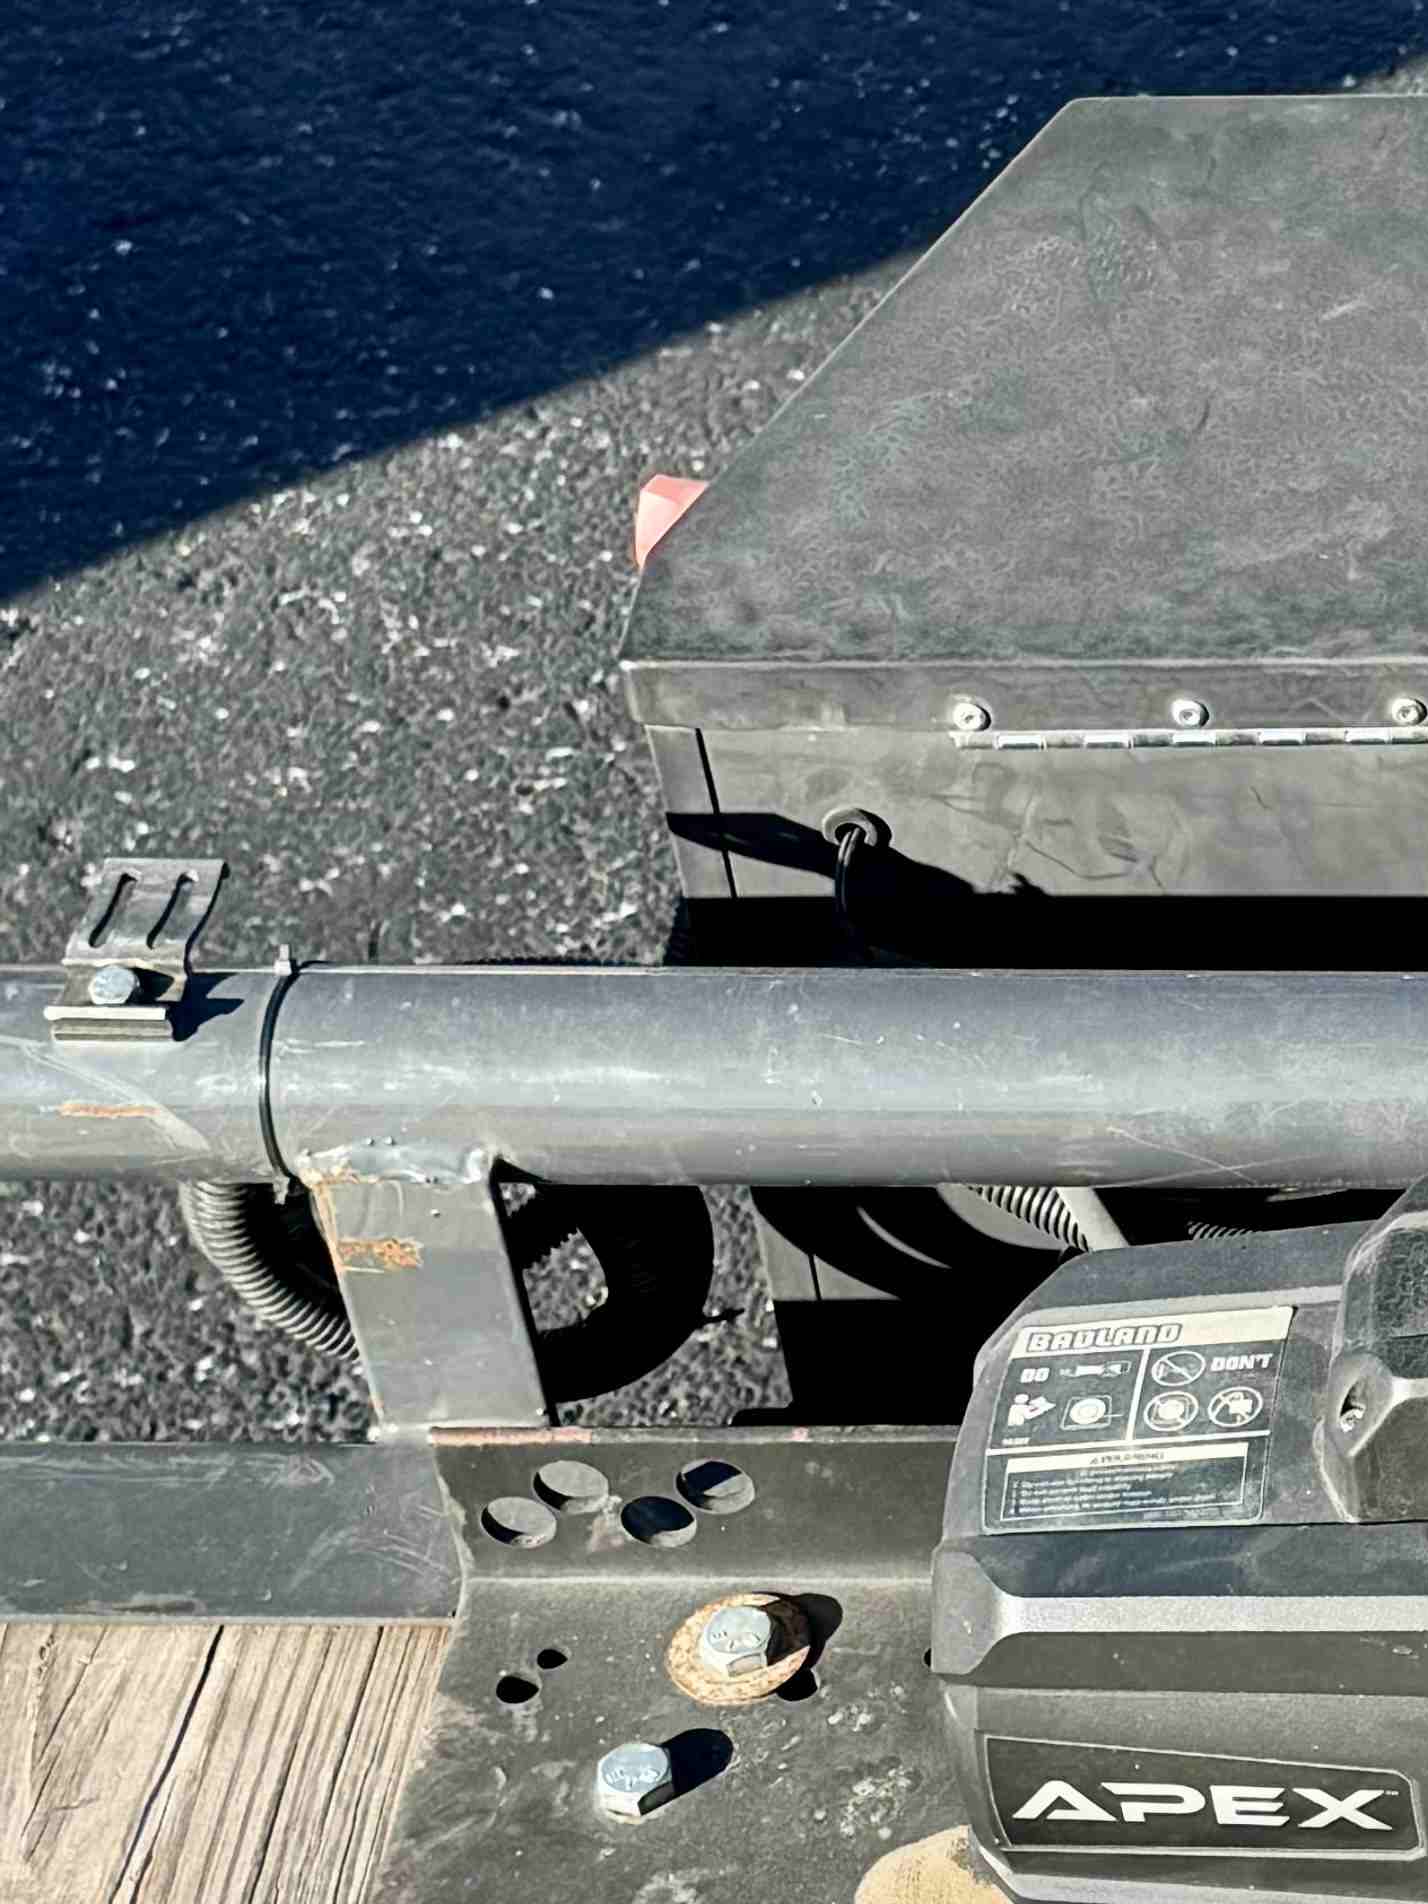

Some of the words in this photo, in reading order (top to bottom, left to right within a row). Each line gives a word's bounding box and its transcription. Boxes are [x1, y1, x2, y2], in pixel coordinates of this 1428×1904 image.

[1028, 1323, 1182, 1352] BADLAND
[1210, 1353, 1273, 1371] DON'T
[1020, 1368, 1050, 1383] DO
[1012, 1779, 1394, 1831] APEX
